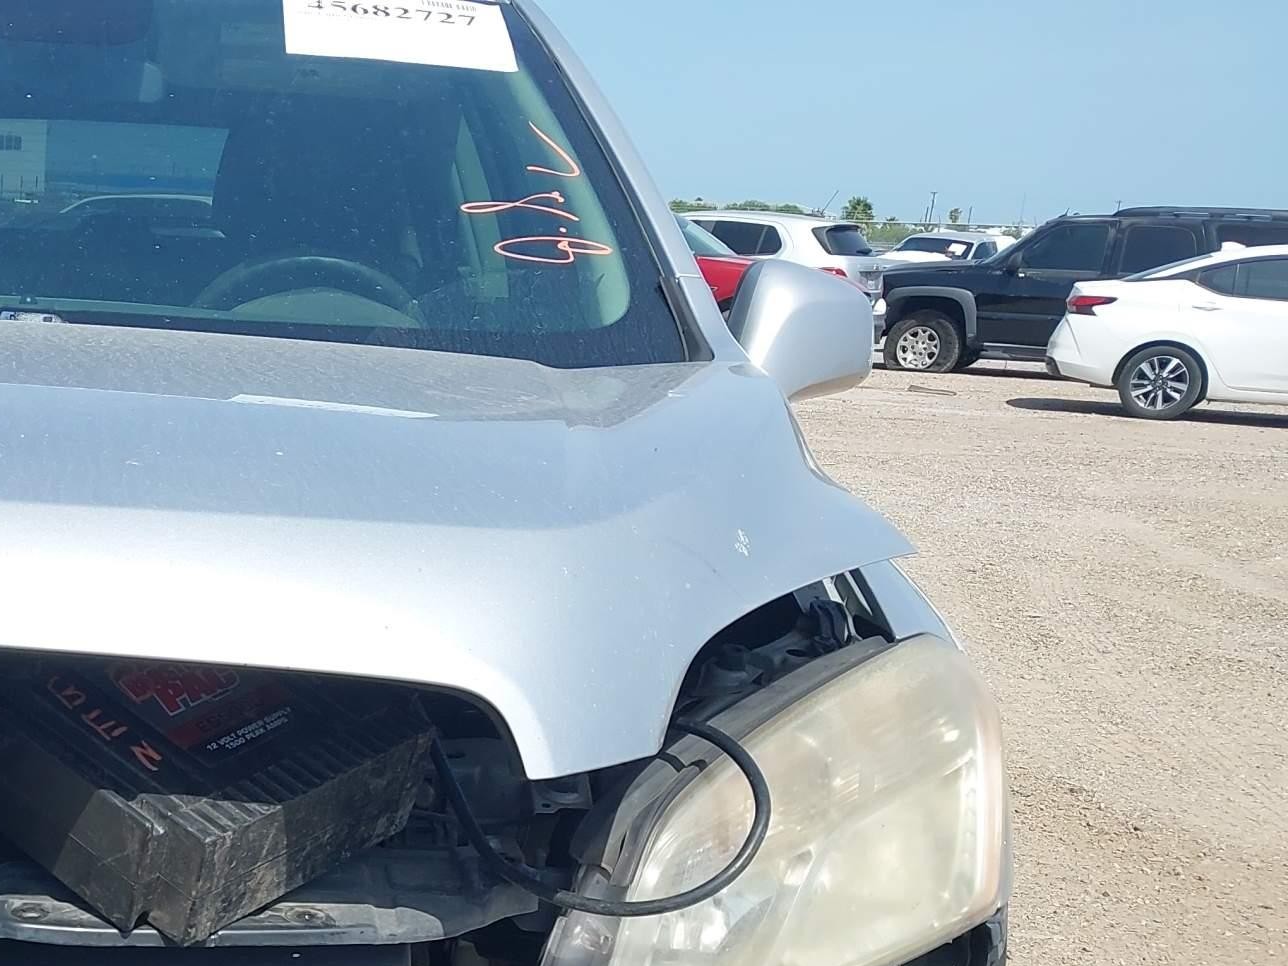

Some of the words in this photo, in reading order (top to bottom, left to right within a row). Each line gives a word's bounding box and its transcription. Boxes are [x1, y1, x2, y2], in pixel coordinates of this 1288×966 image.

[307, 0, 476, 26] 45682727
[206, 742, 218, 752] 12
[216, 732, 237, 746] VOLT
[236, 718, 264, 737] POWER
[224, 736, 246, 751] 1500
